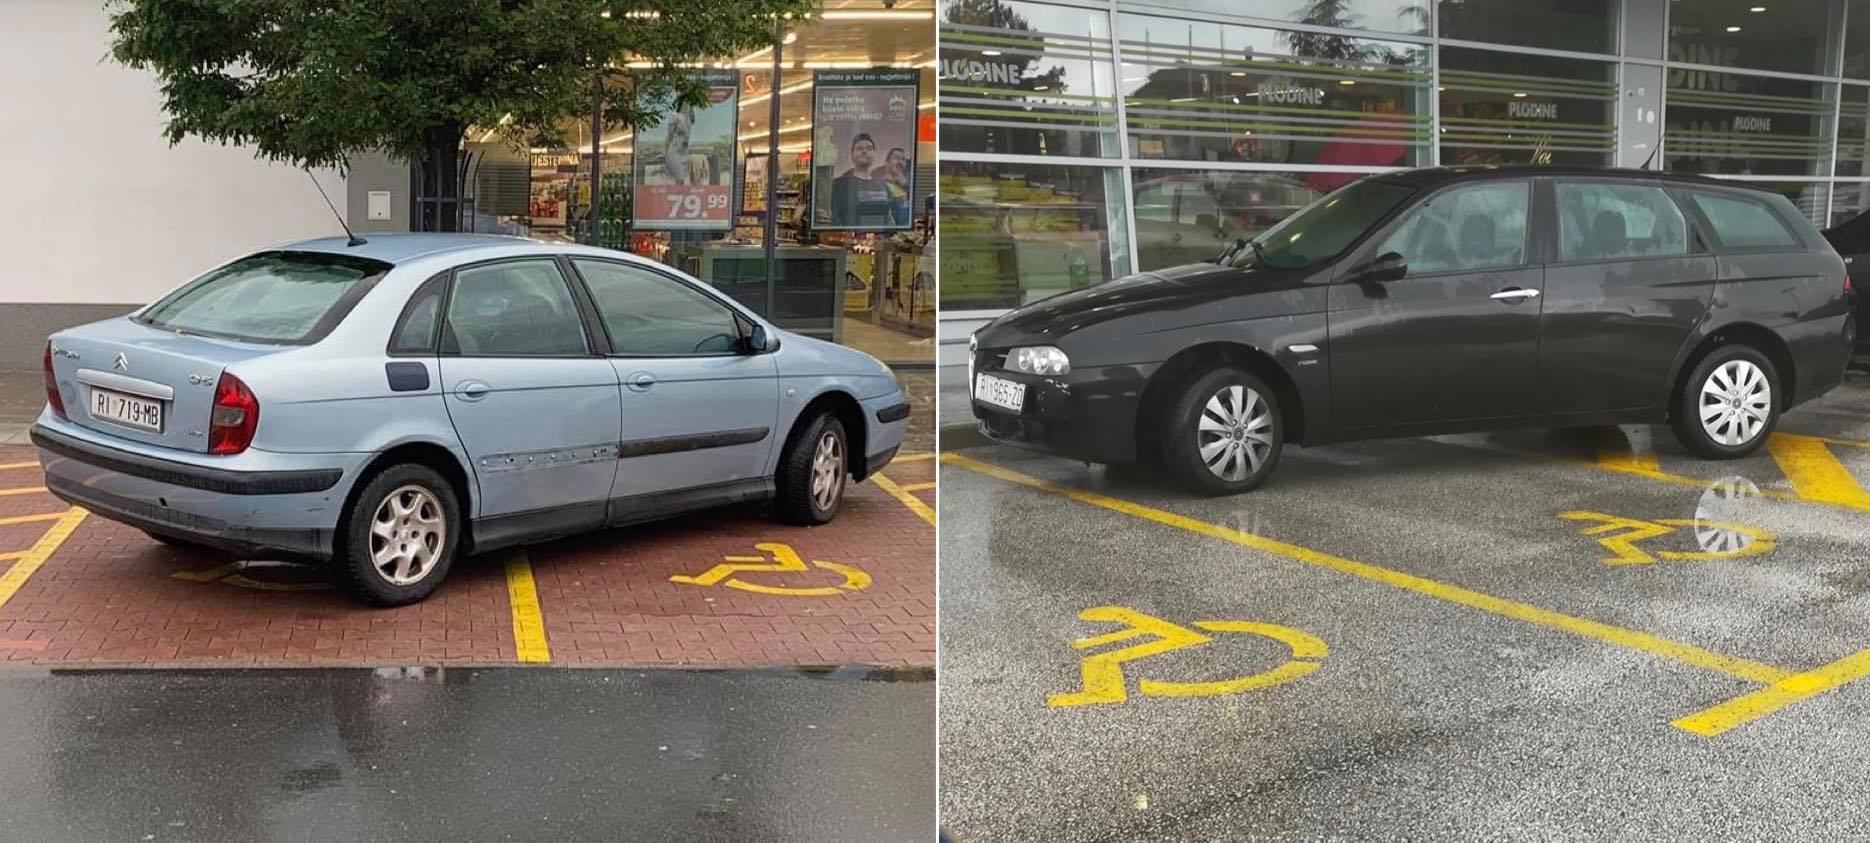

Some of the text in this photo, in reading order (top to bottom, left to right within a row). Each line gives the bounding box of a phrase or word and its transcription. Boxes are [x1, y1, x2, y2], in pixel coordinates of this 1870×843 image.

[1257, 84, 1323, 105] PLODINE
[1508, 101, 1558, 119] PLODINE
[1734, 116, 1771, 132] PLODINE
[97, 393, 159, 426] RI 719-MB
